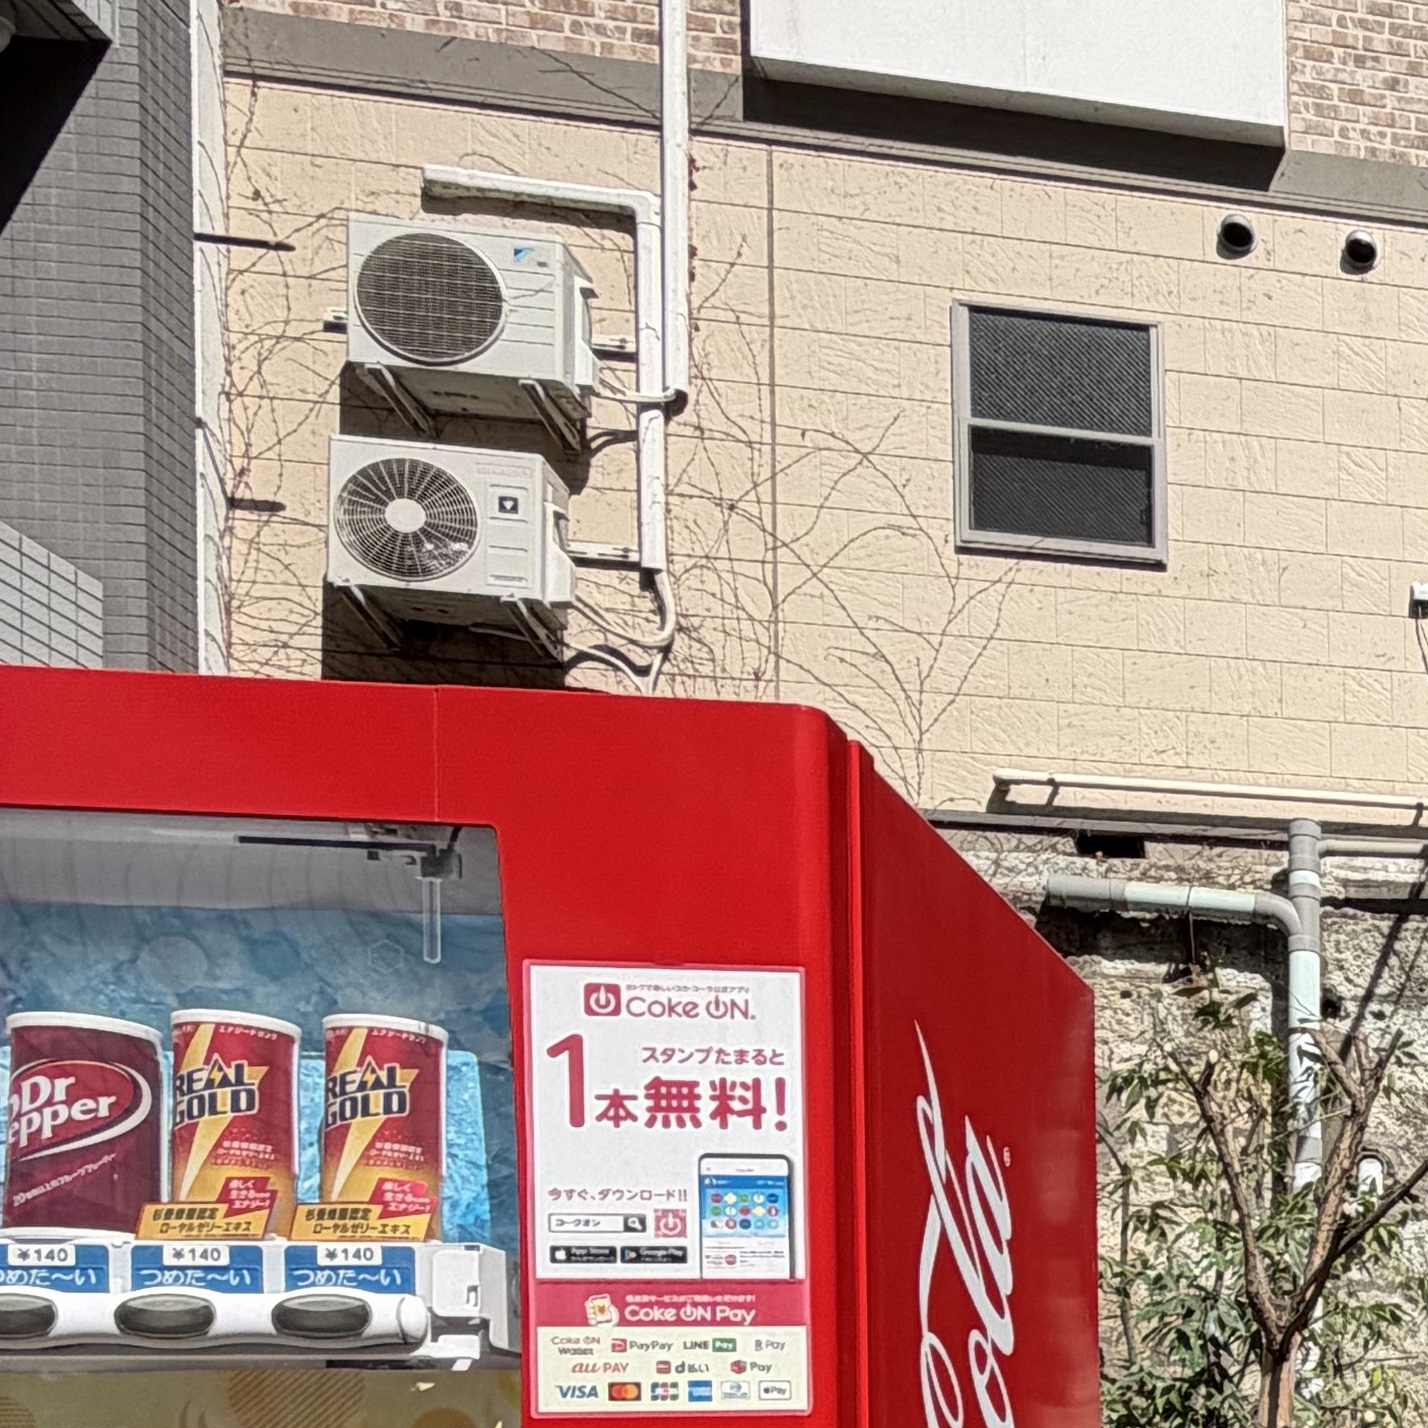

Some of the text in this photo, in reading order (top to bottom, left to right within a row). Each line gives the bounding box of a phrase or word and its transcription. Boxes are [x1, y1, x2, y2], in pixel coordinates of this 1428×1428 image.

[626, 996, 700, 1019] Coke
[641, 1046, 785, 1067] スタンプたまると
[174, 1054, 256, 1098] REAL
[326, 1059, 407, 1101] REAL
[20, 1075, 76, 1115] Dr
[174, 1088, 256, 1126] GOLD
[326, 1089, 407, 1128] GOLD
[17, 1247, 69, 1262] ¥140
[171, 1247, 221, 1262] ¥140
[325, 1247, 375, 1262] ¥140
[624, 1302, 756, 1325] Coke ON Pay
[629, 1340, 674, 1352] PayPay
[683, 1341, 734, 1351] LINE Pay
[765, 1339, 786, 1352] Pay
[571, 1362, 629, 1374] au PAY
[750, 1361, 773, 1374] Pay
[555, 1384, 600, 1399] VISA
